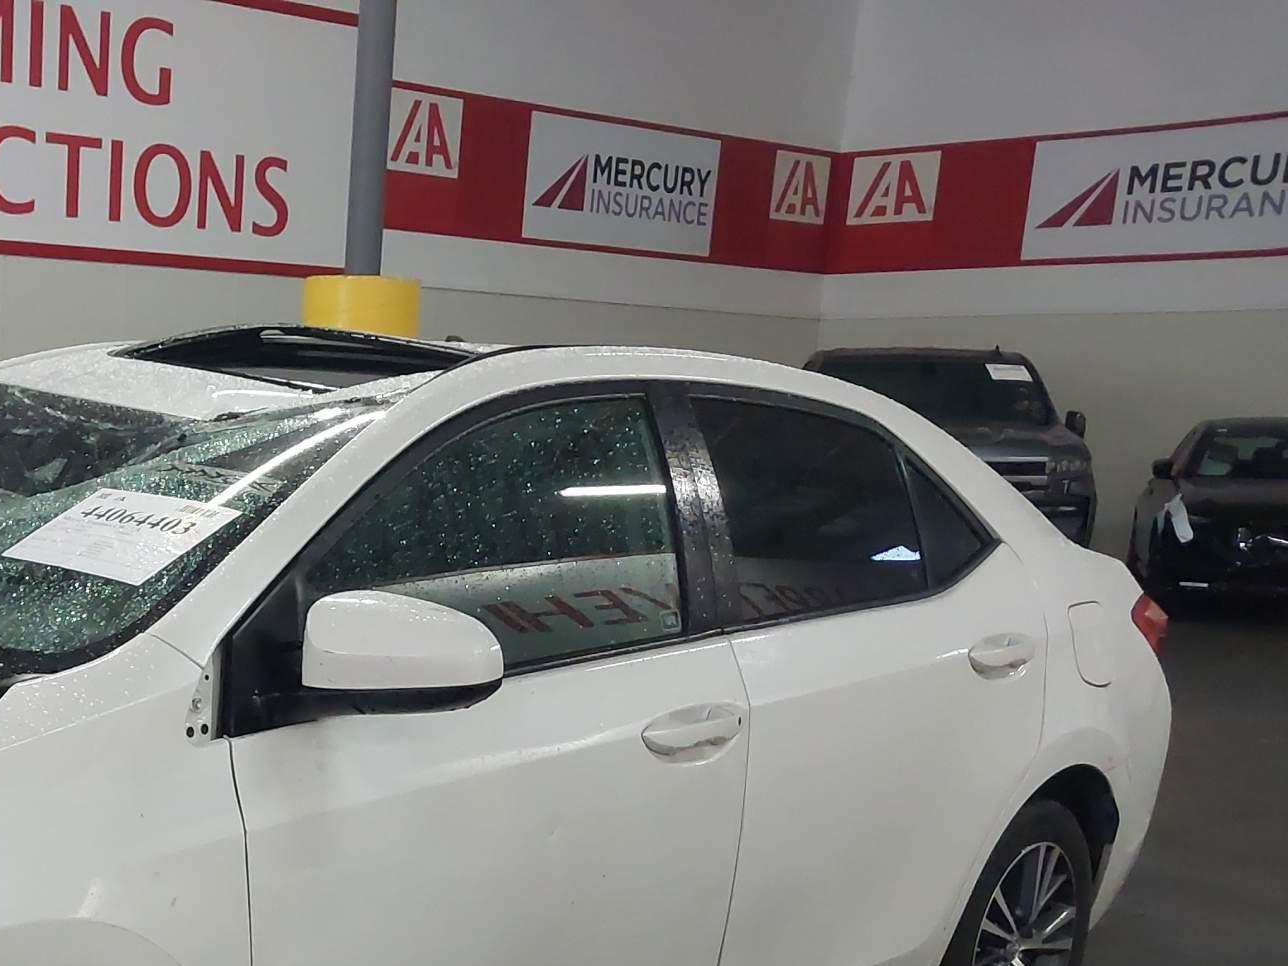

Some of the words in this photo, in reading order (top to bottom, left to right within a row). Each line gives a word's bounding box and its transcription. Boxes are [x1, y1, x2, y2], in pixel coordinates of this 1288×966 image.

[592, 153, 711, 197] MERCURY
[1126, 152, 1288, 196] MERCU
[590, 188, 708, 226] INSURANCE
[81, 505, 197, 534] 44064403
